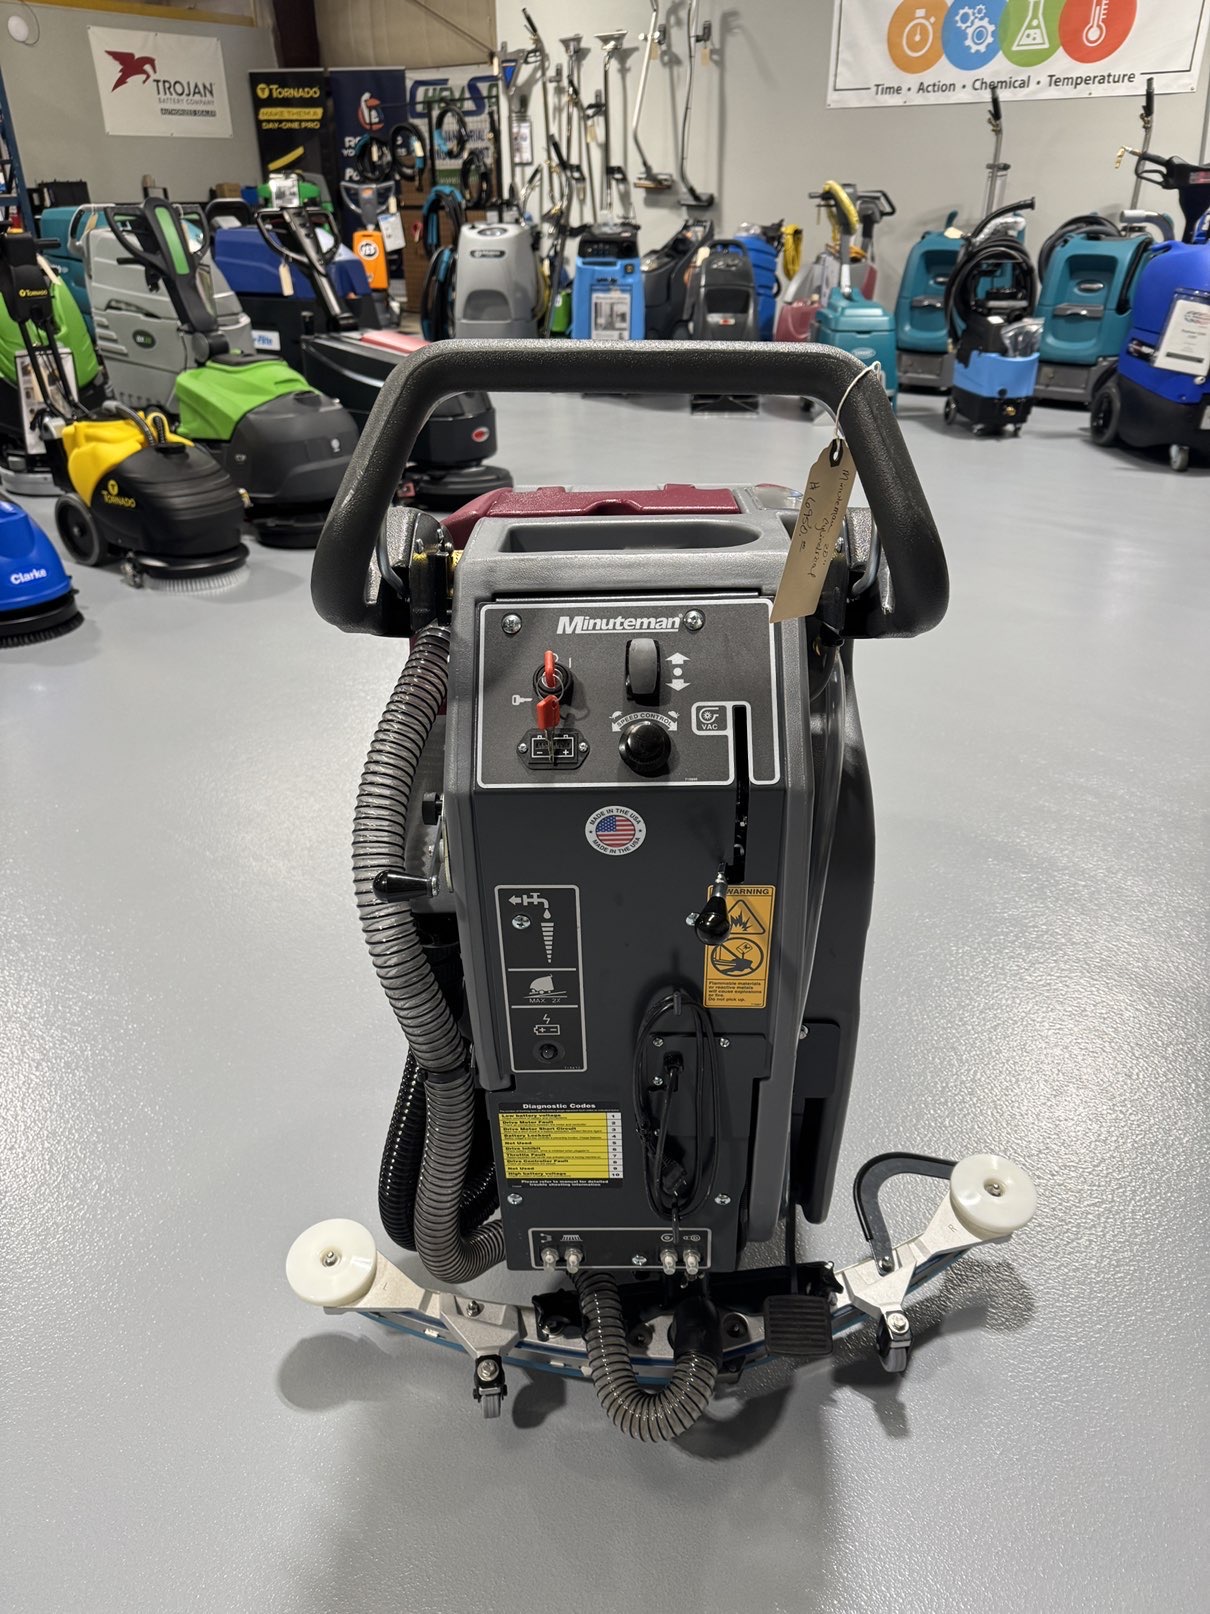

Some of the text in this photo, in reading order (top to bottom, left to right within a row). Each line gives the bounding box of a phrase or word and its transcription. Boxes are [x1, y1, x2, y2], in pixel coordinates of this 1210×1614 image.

[153, 79, 214, 98] TROJAN
[269, 84, 320, 98] TORNADO
[874, 72, 1136, 96] Time Action Chemical Temperature
[262, 122, 300, 130] DAY-ONE
[102, 490, 136, 508] TORNADO
[10, 566, 47, 584] Clarke
[556, 614, 680, 635] Minuteman
[617, 712, 673, 727] SPEED CONTROL
[590, 812, 606, 826] MADE
[630, 812, 642, 825] USA
[592, 839, 608, 853] MADE
[630, 836, 641, 848] USA
